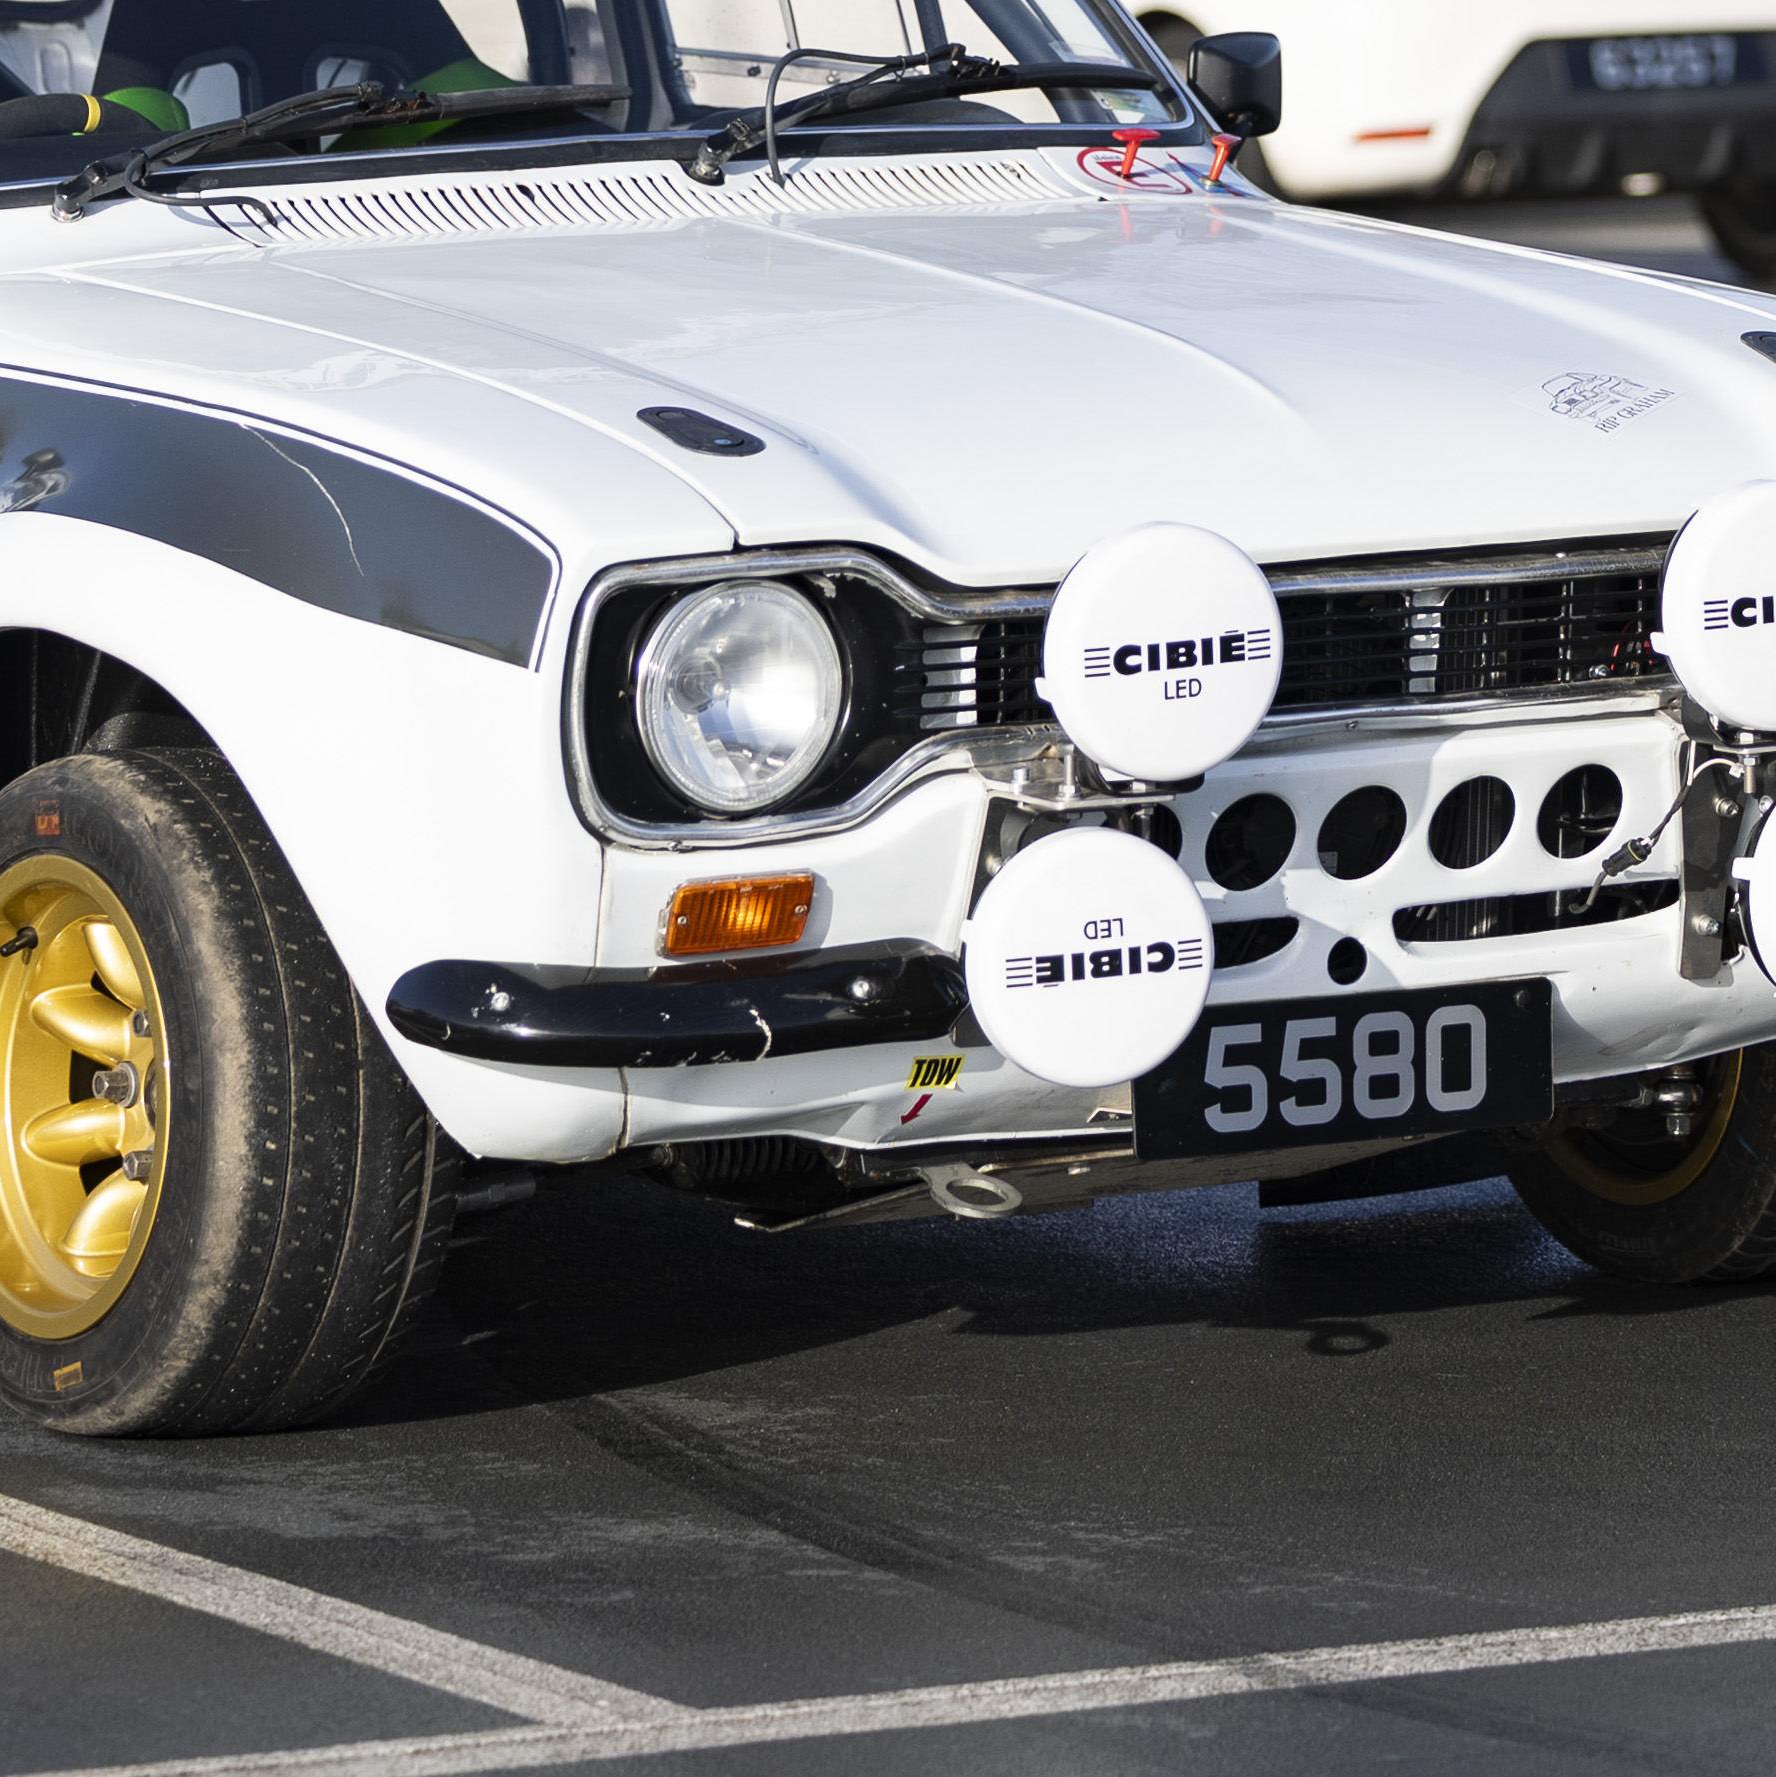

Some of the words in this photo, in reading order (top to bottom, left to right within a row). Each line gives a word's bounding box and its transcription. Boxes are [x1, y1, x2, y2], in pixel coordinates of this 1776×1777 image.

[1594, 416, 1620, 434] RIP
[1617, 388, 1675, 419] GRAHAM
[1164, 678, 1202, 700] LED
[1083, 918, 1124, 940] LED
[909, 1057, 962, 1088] TOW
[1204, 1004, 1487, 1133] 5580
